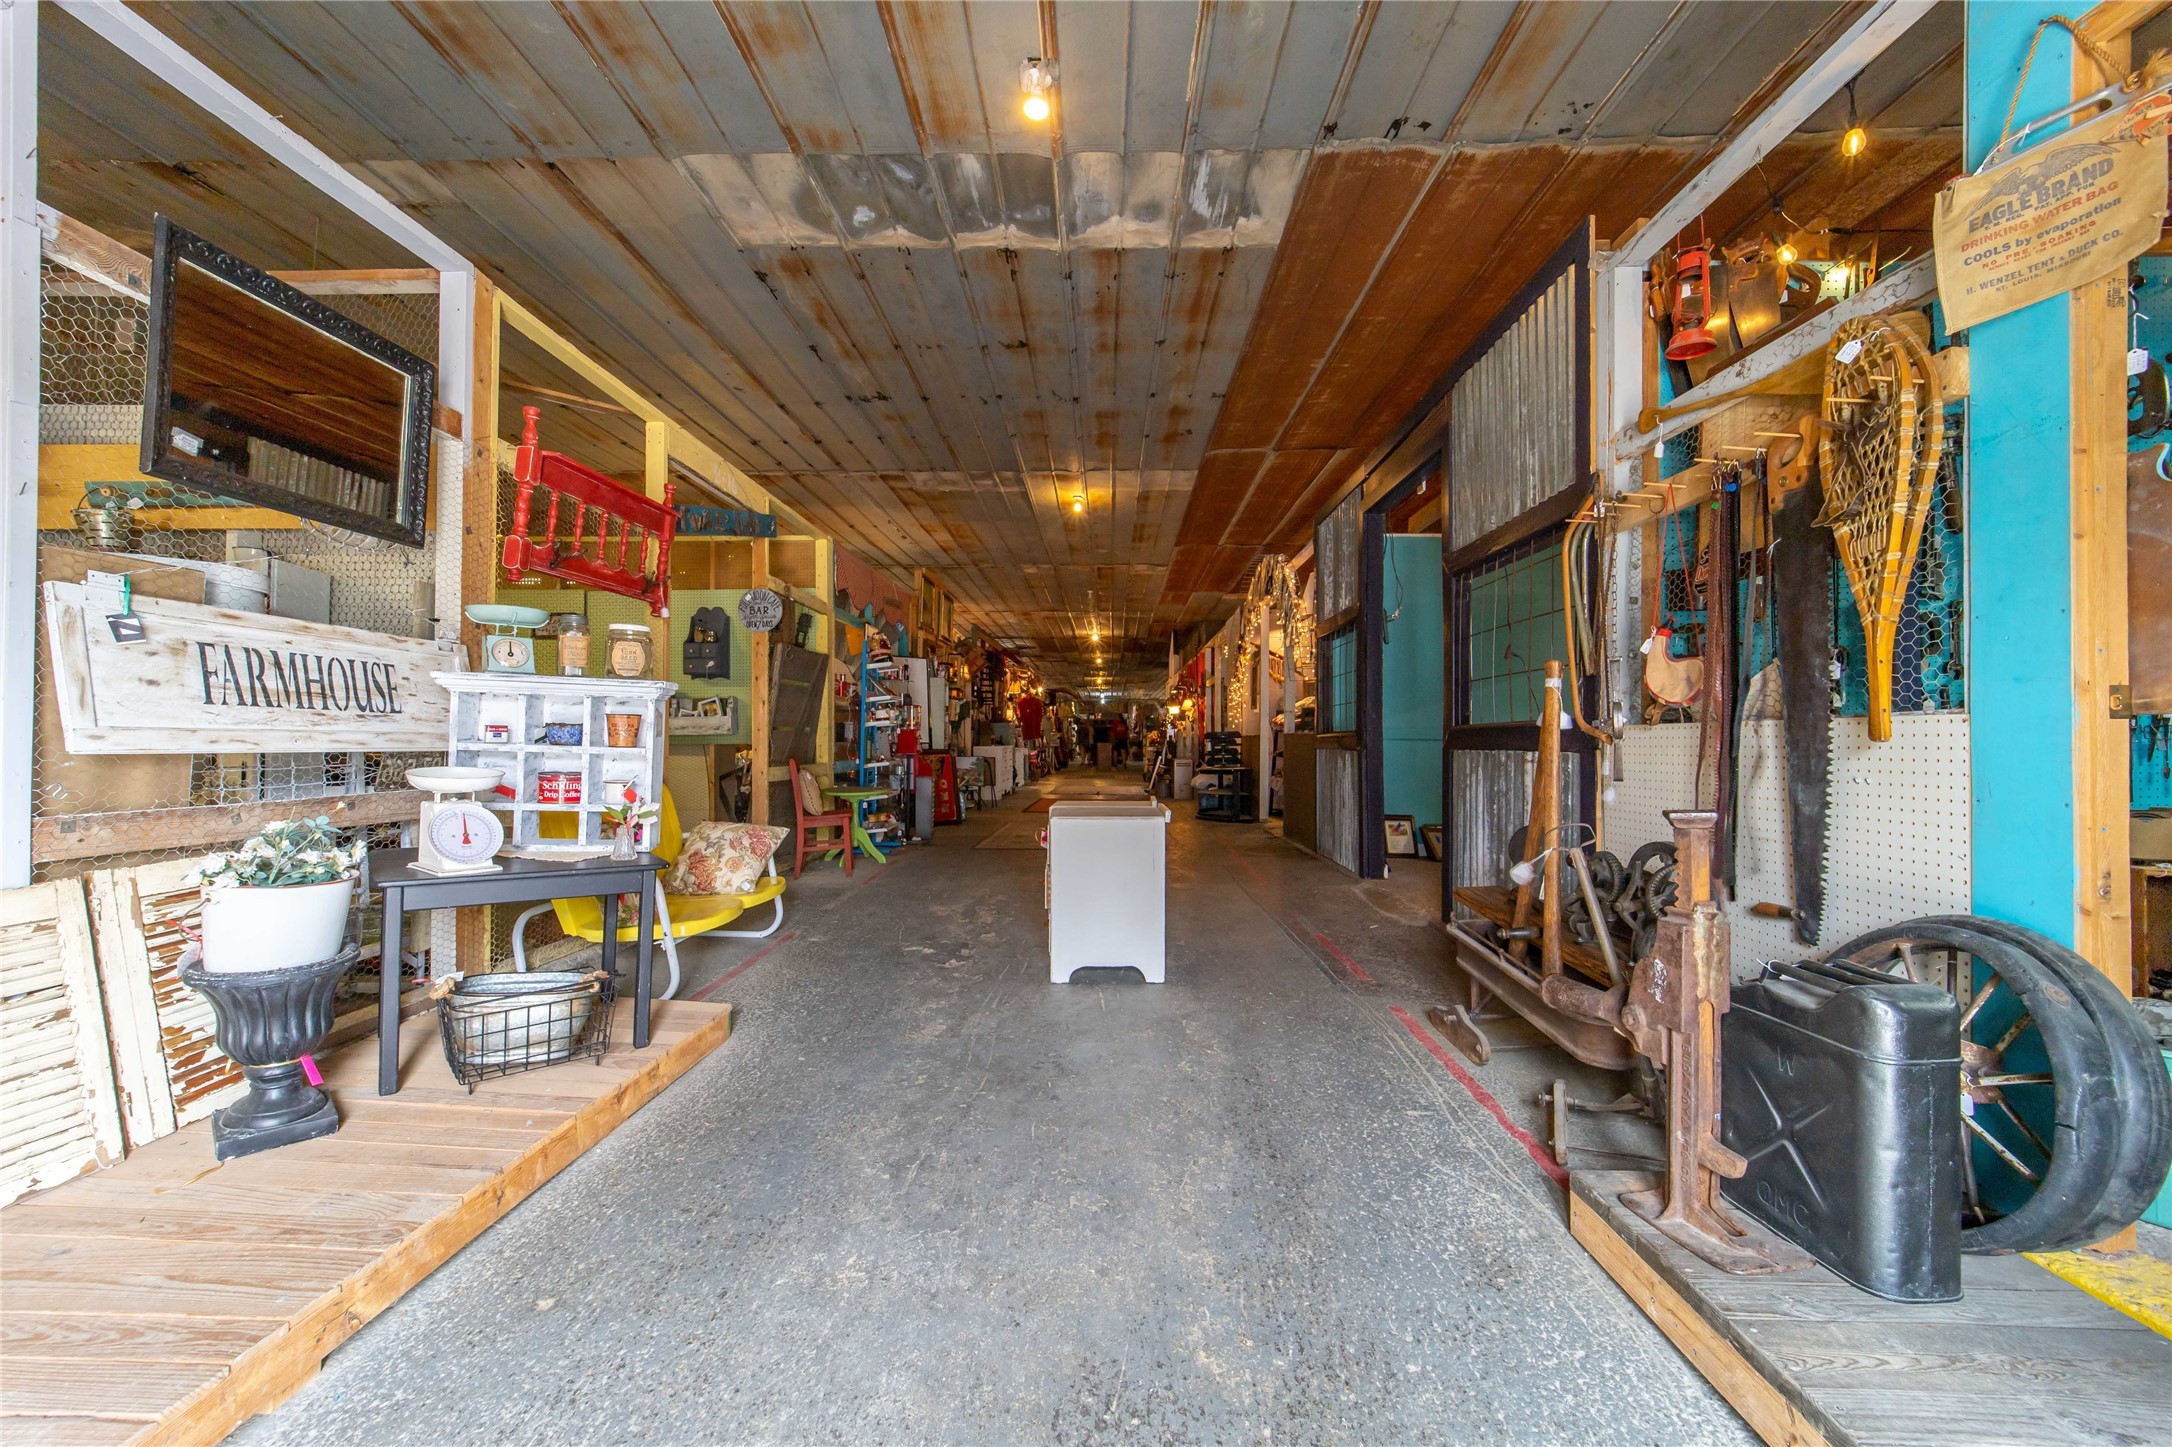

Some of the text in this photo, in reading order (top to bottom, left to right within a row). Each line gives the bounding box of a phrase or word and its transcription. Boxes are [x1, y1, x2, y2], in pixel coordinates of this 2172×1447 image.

[1968, 157, 2114, 233] EAGLE BRAND
[2005, 213, 2025, 222] REG.
[2034, 202, 2053, 211] PAT.
[2055, 191, 2074, 202] APP.
[2077, 181, 2095, 192] FOR
[1961, 180, 2119, 253] DRINKING WATER BAG
[1963, 197, 2122, 266] COOLS by evaporation
[1966, 286, 1977, 295] H.
[1979, 269, 2025, 290] WENZEL
[2026, 256, 2056, 274] TENT
[2067, 237, 2099, 258] DUCK
[2102, 229, 2124, 242] CO.
[1982, 259, 1998, 270] NO
[1995, 250, 2091, 293] ST. LOUIS, MISSOURI
[748, 605, 770, 615] BAR
[195, 641, 403, 714] FARMHOUSE
[542, 780, 582, 792] Schlin
[543, 790, 559, 799] Drip
[1681, 1043, 1691, 1081] BUDA
[1776, 1045, 1797, 1077] W
[1756, 1180, 1813, 1234] QMC
